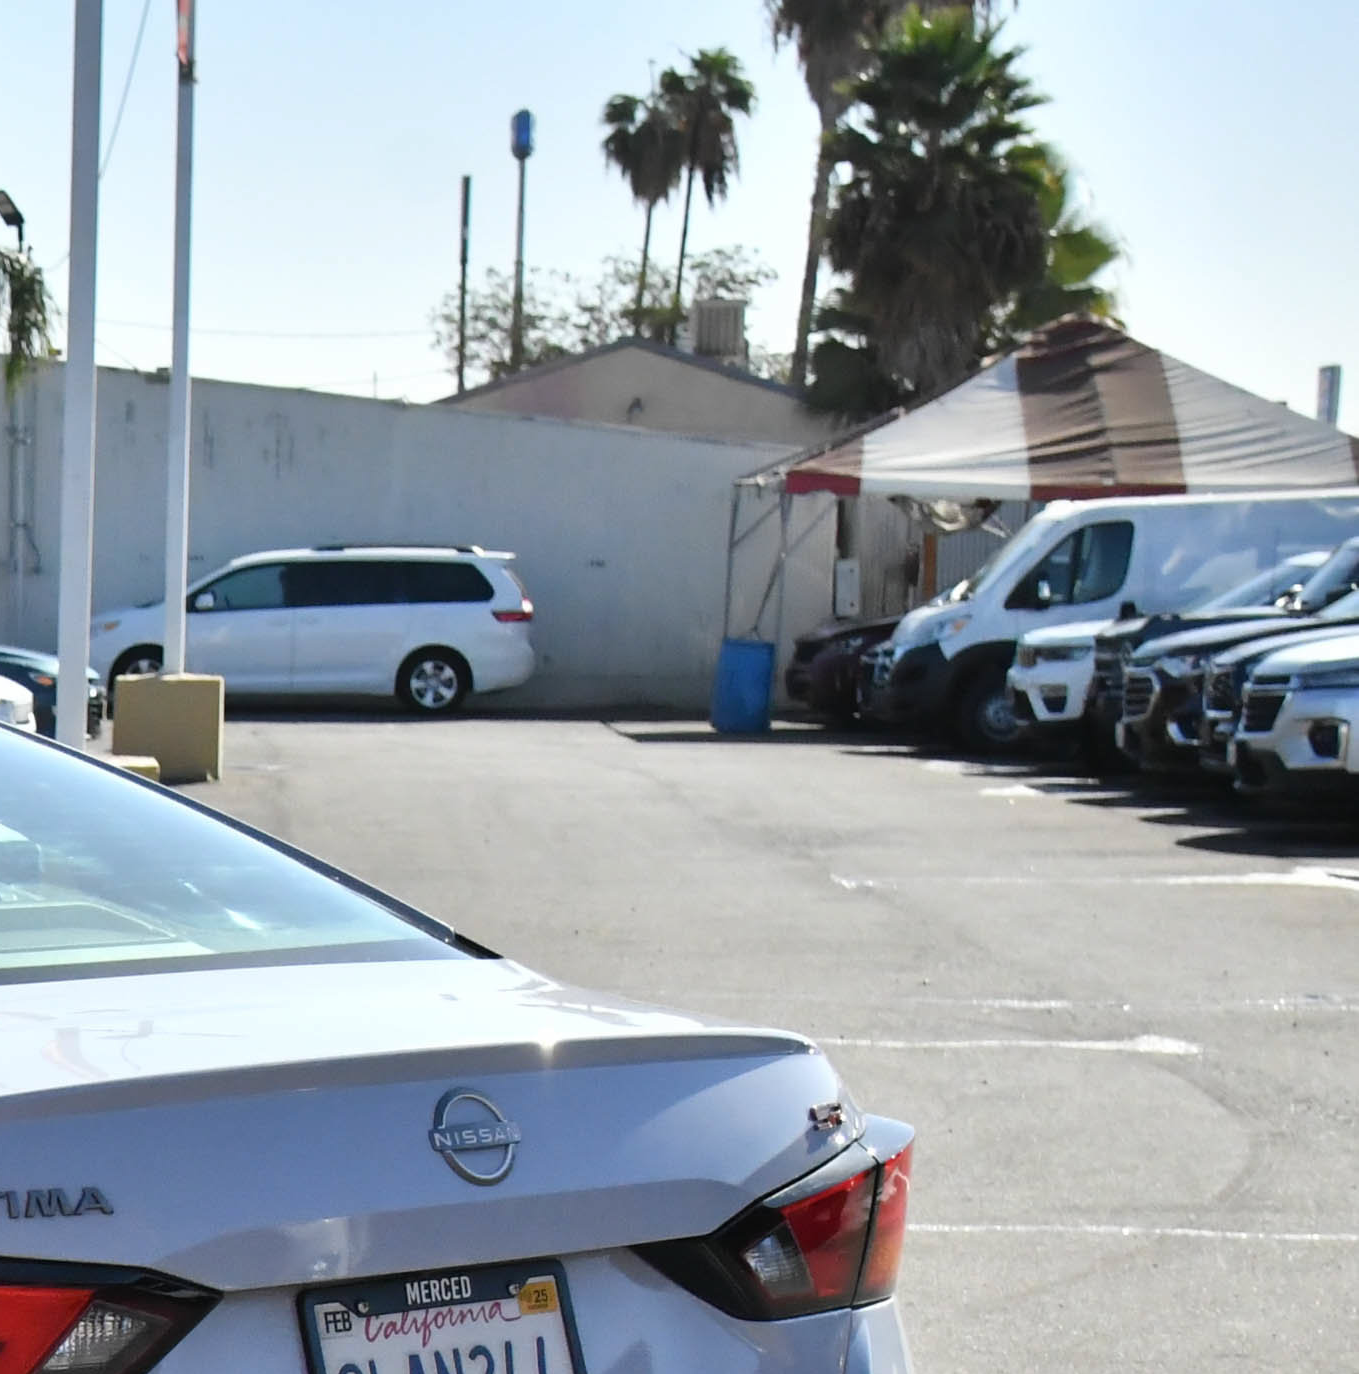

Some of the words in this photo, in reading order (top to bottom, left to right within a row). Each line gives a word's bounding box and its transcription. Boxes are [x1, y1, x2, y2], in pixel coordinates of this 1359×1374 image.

[433, 1124, 521, 1147] NISSAN
[405, 1275, 472, 1305] MERCED
[532, 1288, 549, 1304] 25
[324, 1310, 352, 1333] FEB
[364, 1301, 522, 1348] California
